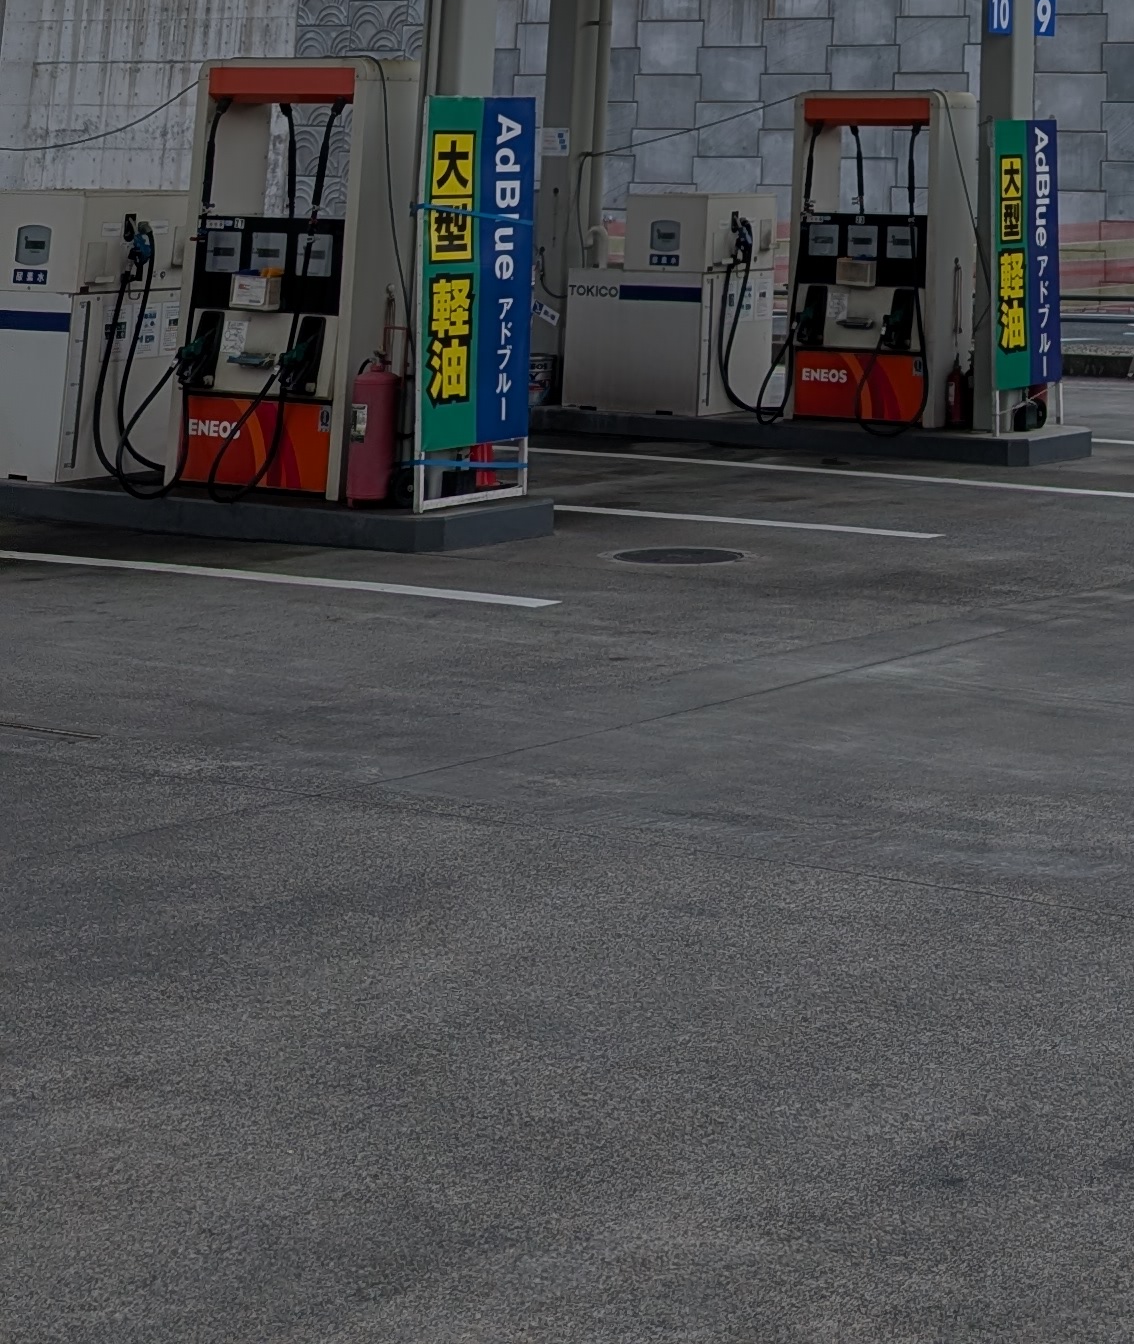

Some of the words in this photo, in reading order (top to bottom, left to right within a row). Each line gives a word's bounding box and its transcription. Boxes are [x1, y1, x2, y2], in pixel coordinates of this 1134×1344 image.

[435, 140, 470, 254] 大型
[1003, 160, 1020, 237] 大型
[1034, 127, 1050, 248] AdBlue
[430, 278, 471, 399] 軽油
[568, 285, 619, 297] TOKICO
[1000, 252, 1025, 349] 軽油
[1036, 256, 1051, 377] アドブルー
[496, 298, 513, 421] アドブルー
[802, 367, 848, 383] ENEOS
